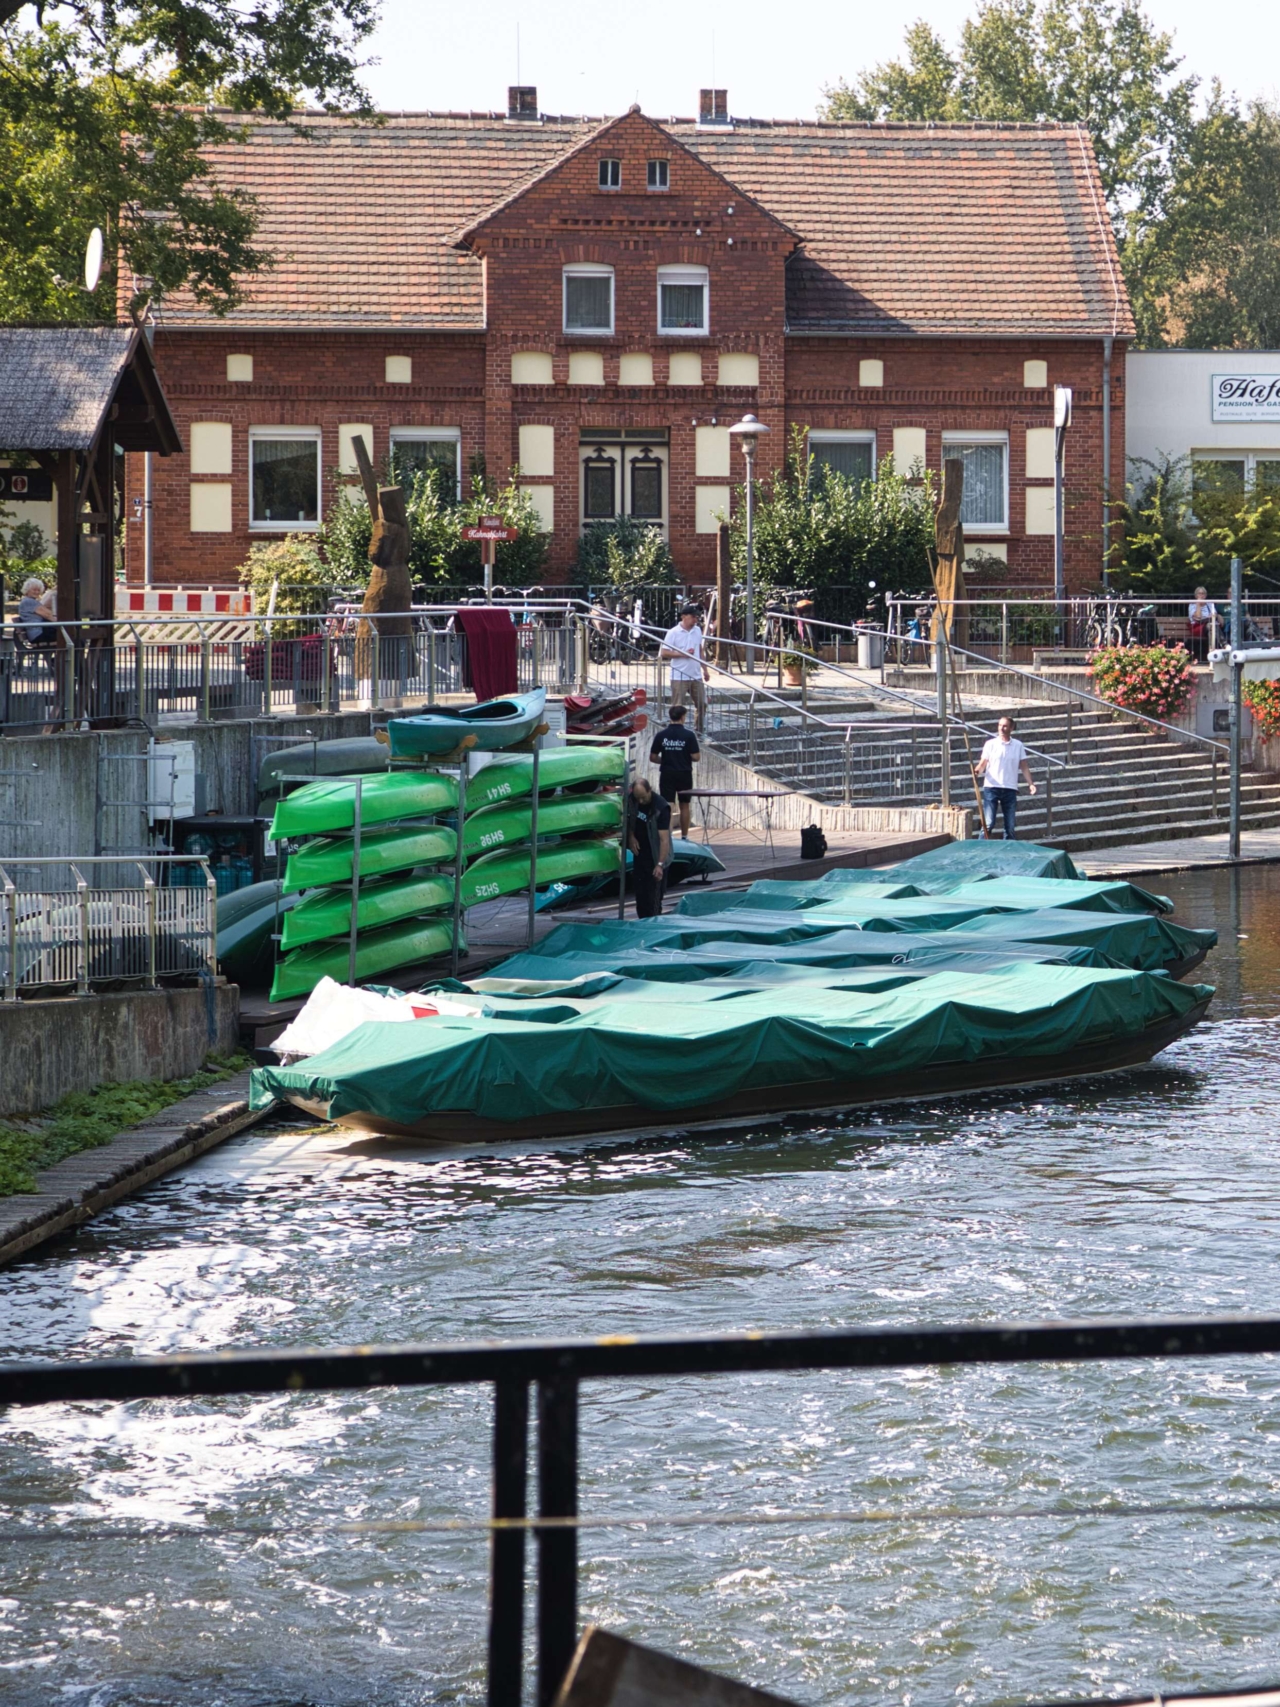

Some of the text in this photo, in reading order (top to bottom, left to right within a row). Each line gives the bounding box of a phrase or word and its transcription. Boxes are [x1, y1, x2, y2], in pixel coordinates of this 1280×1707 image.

[134, 506, 143, 517] 7
[487, 782, 512, 800] SH41
[475, 882, 500, 897] SH25
